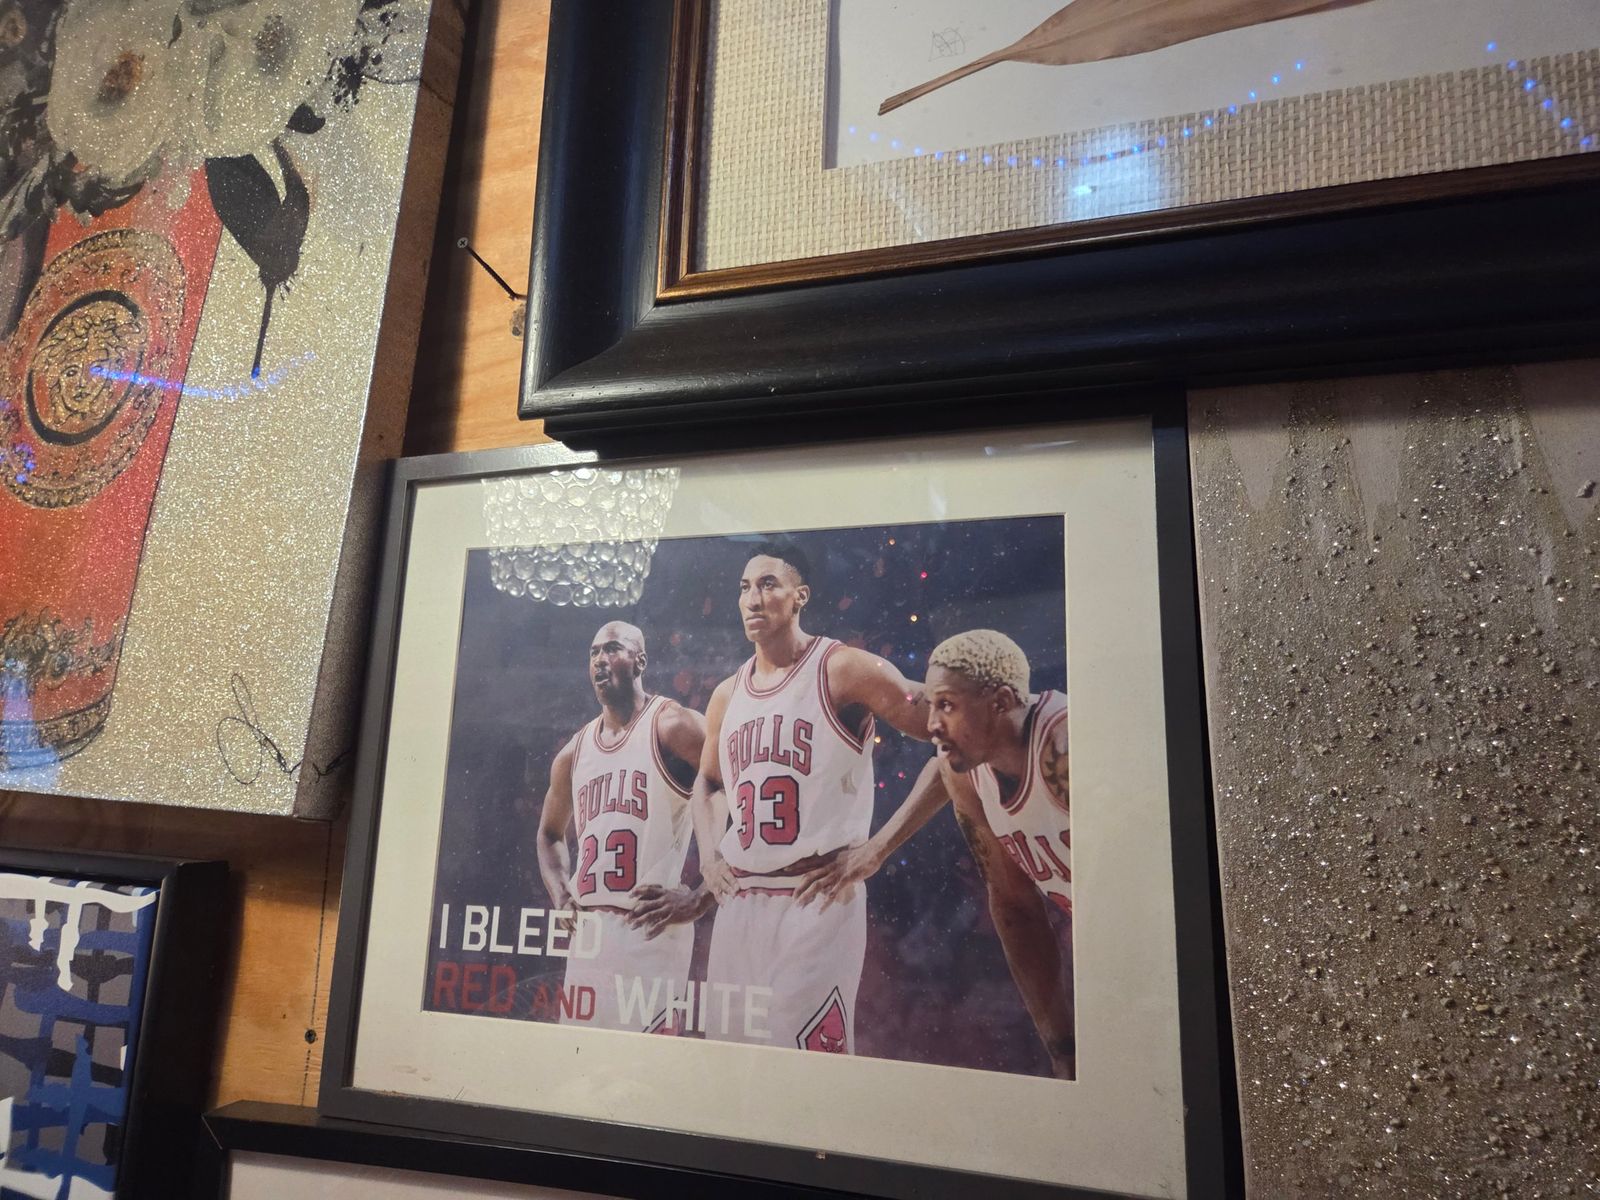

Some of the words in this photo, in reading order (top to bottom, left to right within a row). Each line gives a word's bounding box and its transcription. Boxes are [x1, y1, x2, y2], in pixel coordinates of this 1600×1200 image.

[727, 714, 813, 790] BULLS
[577, 769, 649, 838] BULLS
[736, 775, 800, 850] 33
[577, 828, 638, 898] 23
[439, 903, 450, 949] I
[462, 905, 601, 959] BLEED
[433, 961, 517, 1014] RED
[532, 984, 596, 1021] AND
[614, 974, 774, 1038] WHITE
